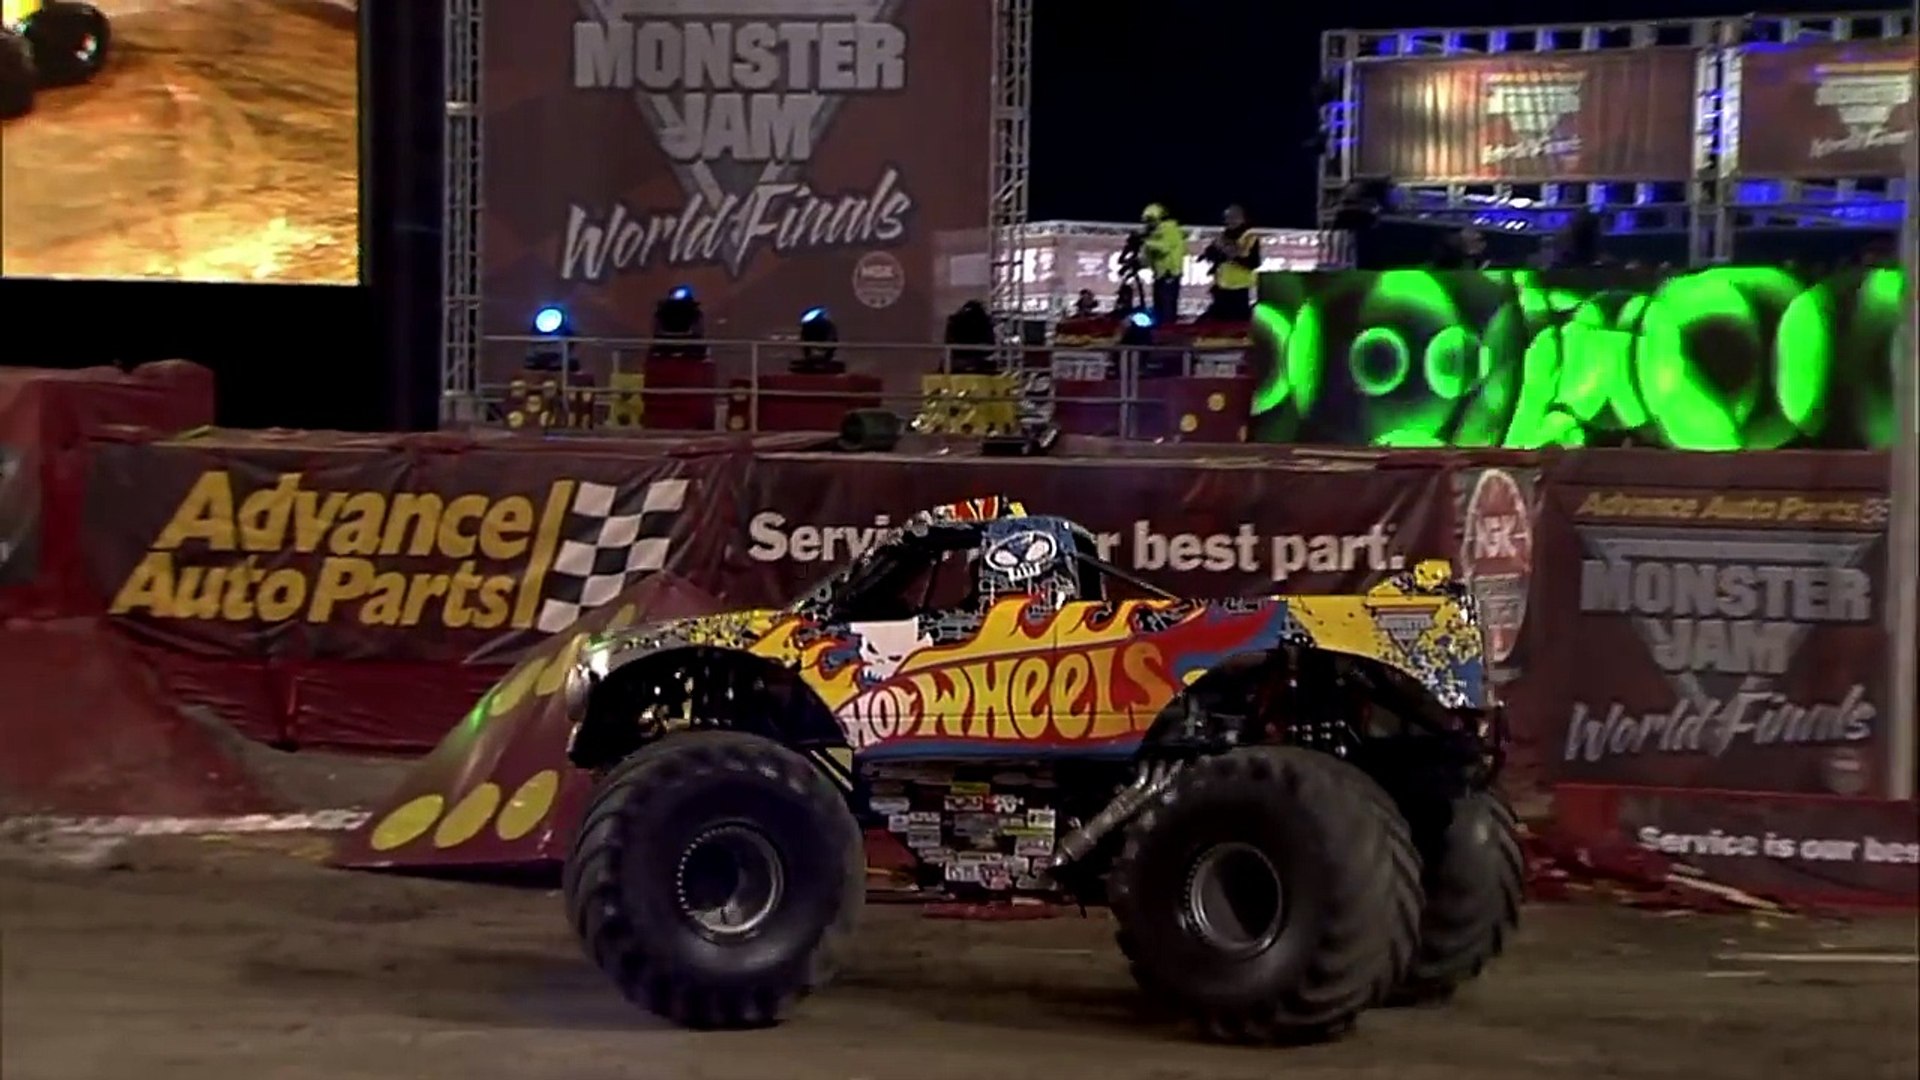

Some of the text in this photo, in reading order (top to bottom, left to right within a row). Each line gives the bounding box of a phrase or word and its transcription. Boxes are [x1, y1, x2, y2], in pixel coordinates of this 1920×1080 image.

[574, 21, 906, 90] MONSTER
[652, 92, 820, 161] JAM
[561, 169, 911, 280] World Finals
[154, 471, 532, 559] Advance
[748, 511, 892, 562] Servi
[1133, 519, 1260, 573] best
[1271, 523, 1406, 582] part.
[109, 551, 515, 628] Auto Parts
[1579, 559, 1872, 621] MONSTER
[1640, 620, 1799, 674] JAM
[834, 642, 1174, 750] HOT WHEELS
[1564, 684, 1877, 762] World Finals
[1638, 826, 1759, 855] Service
[1763, 832, 1796, 858] is
[1801, 839, 1859, 861] our
